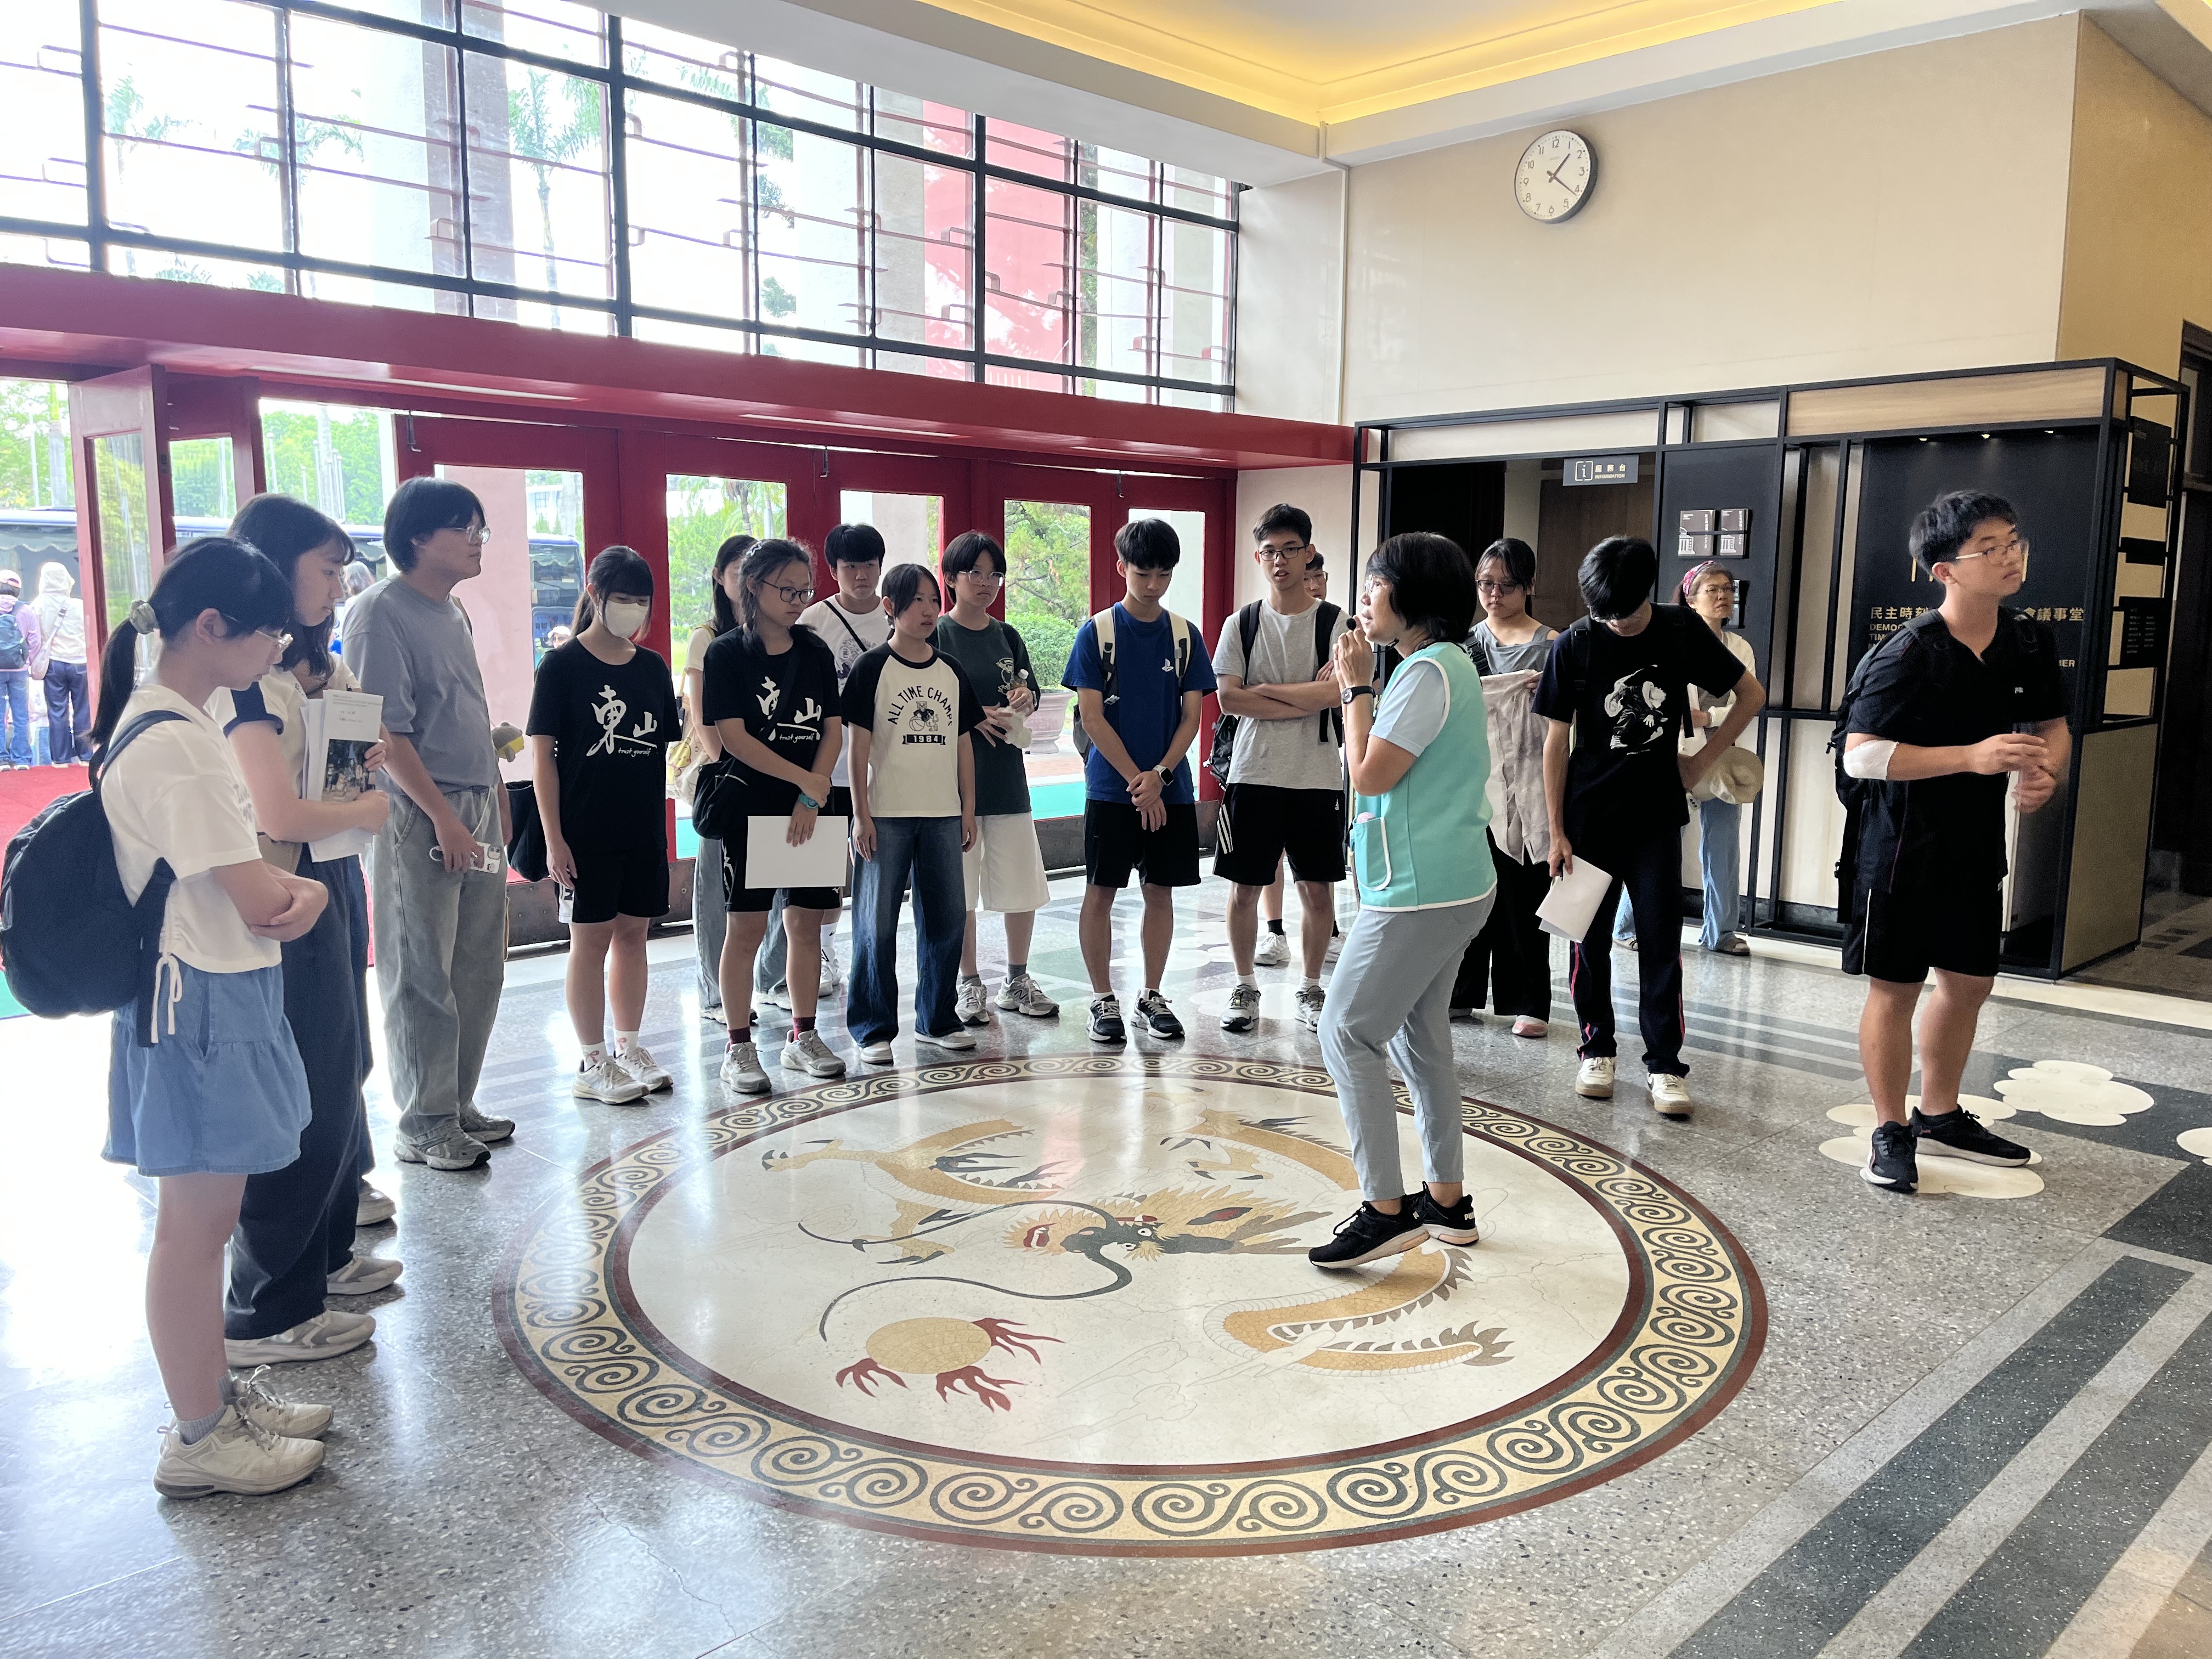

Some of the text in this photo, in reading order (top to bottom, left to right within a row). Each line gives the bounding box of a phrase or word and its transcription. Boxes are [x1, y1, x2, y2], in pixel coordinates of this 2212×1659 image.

[1552, 139, 1559, 148] 12
[1539, 146, 1544, 155] 11
[1577, 150, 1582, 159] 2
[1528, 160, 1534, 169] 10
[1579, 167, 1585, 176] 3
[1523, 177, 1529, 187] 9
[1575, 184, 1580, 193] 4
[1526, 193, 1531, 202] 8
[1536, 203, 1541, 212] 7
[1563, 198, 1569, 208] 5
[1549, 205, 1554, 214] 6
[888, 703, 904, 725] ALL
[898, 686, 924, 703] TIME
[913, 735, 939, 743] 1984
